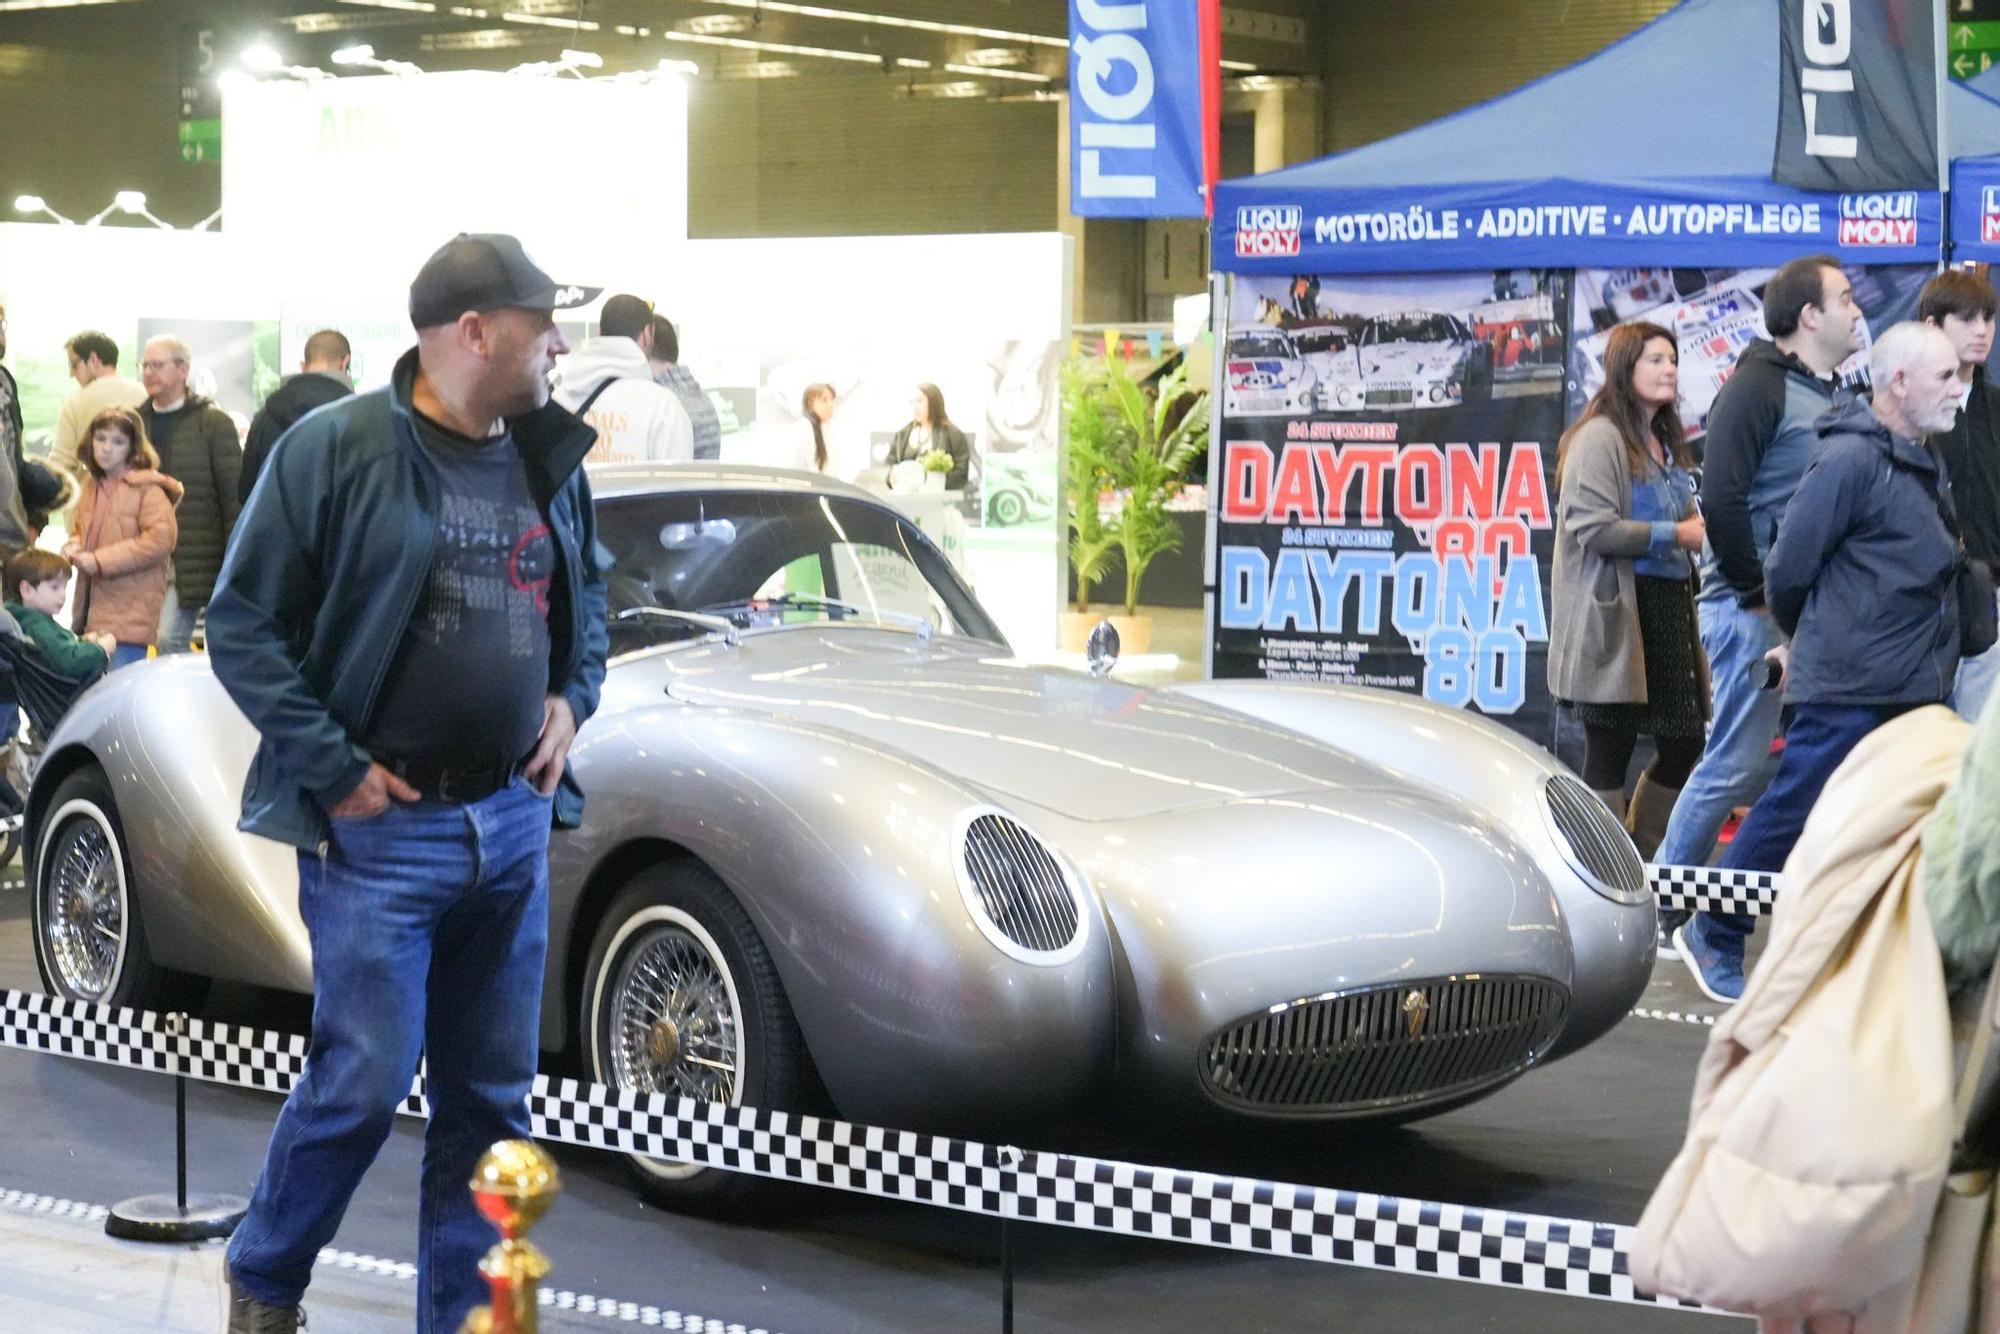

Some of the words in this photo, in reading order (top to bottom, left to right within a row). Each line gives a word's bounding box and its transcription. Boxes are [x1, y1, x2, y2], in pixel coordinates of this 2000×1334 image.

[198, 31, 214, 72] 5
[1240, 208, 1299, 231] LIQUI
[1842, 194, 1913, 219] LIQUI
[1315, 205, 1459, 243] MOTORÖLE
[1477, 205, 1606, 238] ADDITIVE
[1627, 203, 1820, 236] AUTOPFLEGE
[1843, 219, 1915, 244] MOLY
[1238, 230, 1299, 255] MOLY
[1222, 440, 1552, 529] DAYTONA
[1220, 545, 1549, 642] DAYTONA
